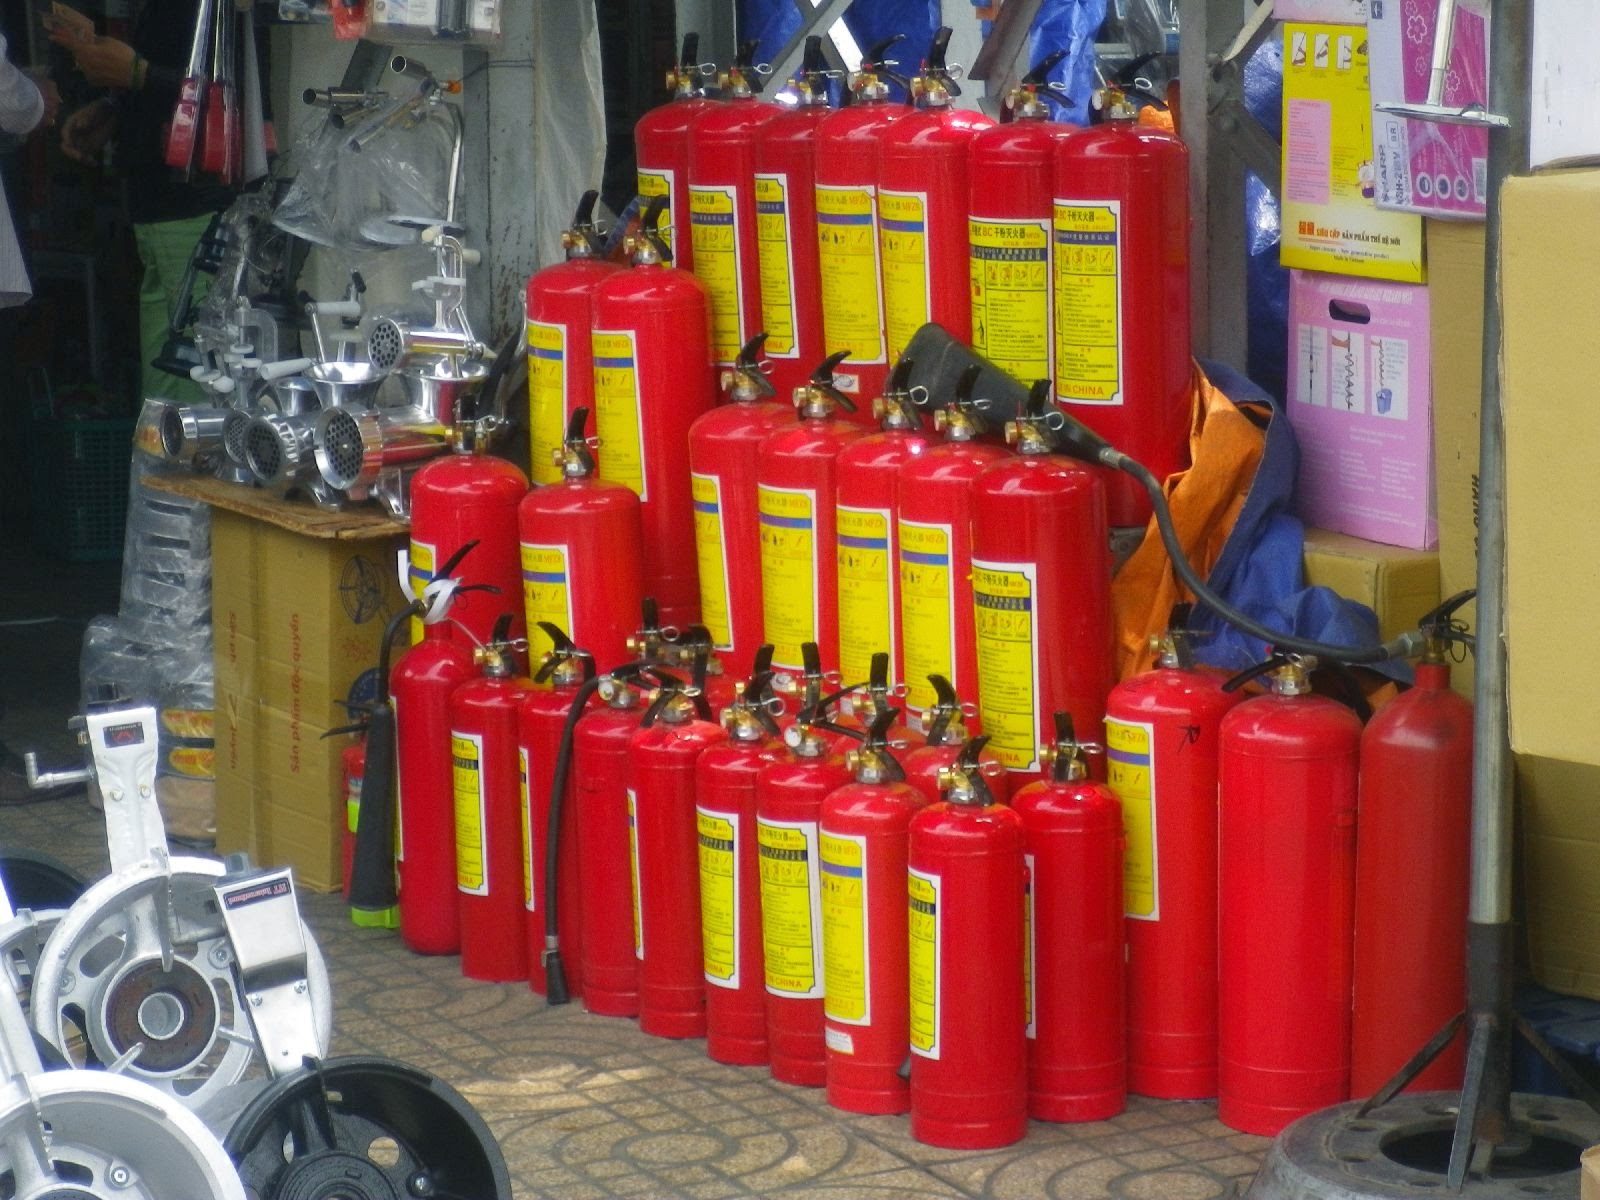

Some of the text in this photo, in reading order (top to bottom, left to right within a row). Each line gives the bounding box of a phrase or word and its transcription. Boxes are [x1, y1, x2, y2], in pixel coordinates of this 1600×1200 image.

[994, 227, 1026, 239] 干粉灭火器
[1072, 384, 1104, 396] CHINA
